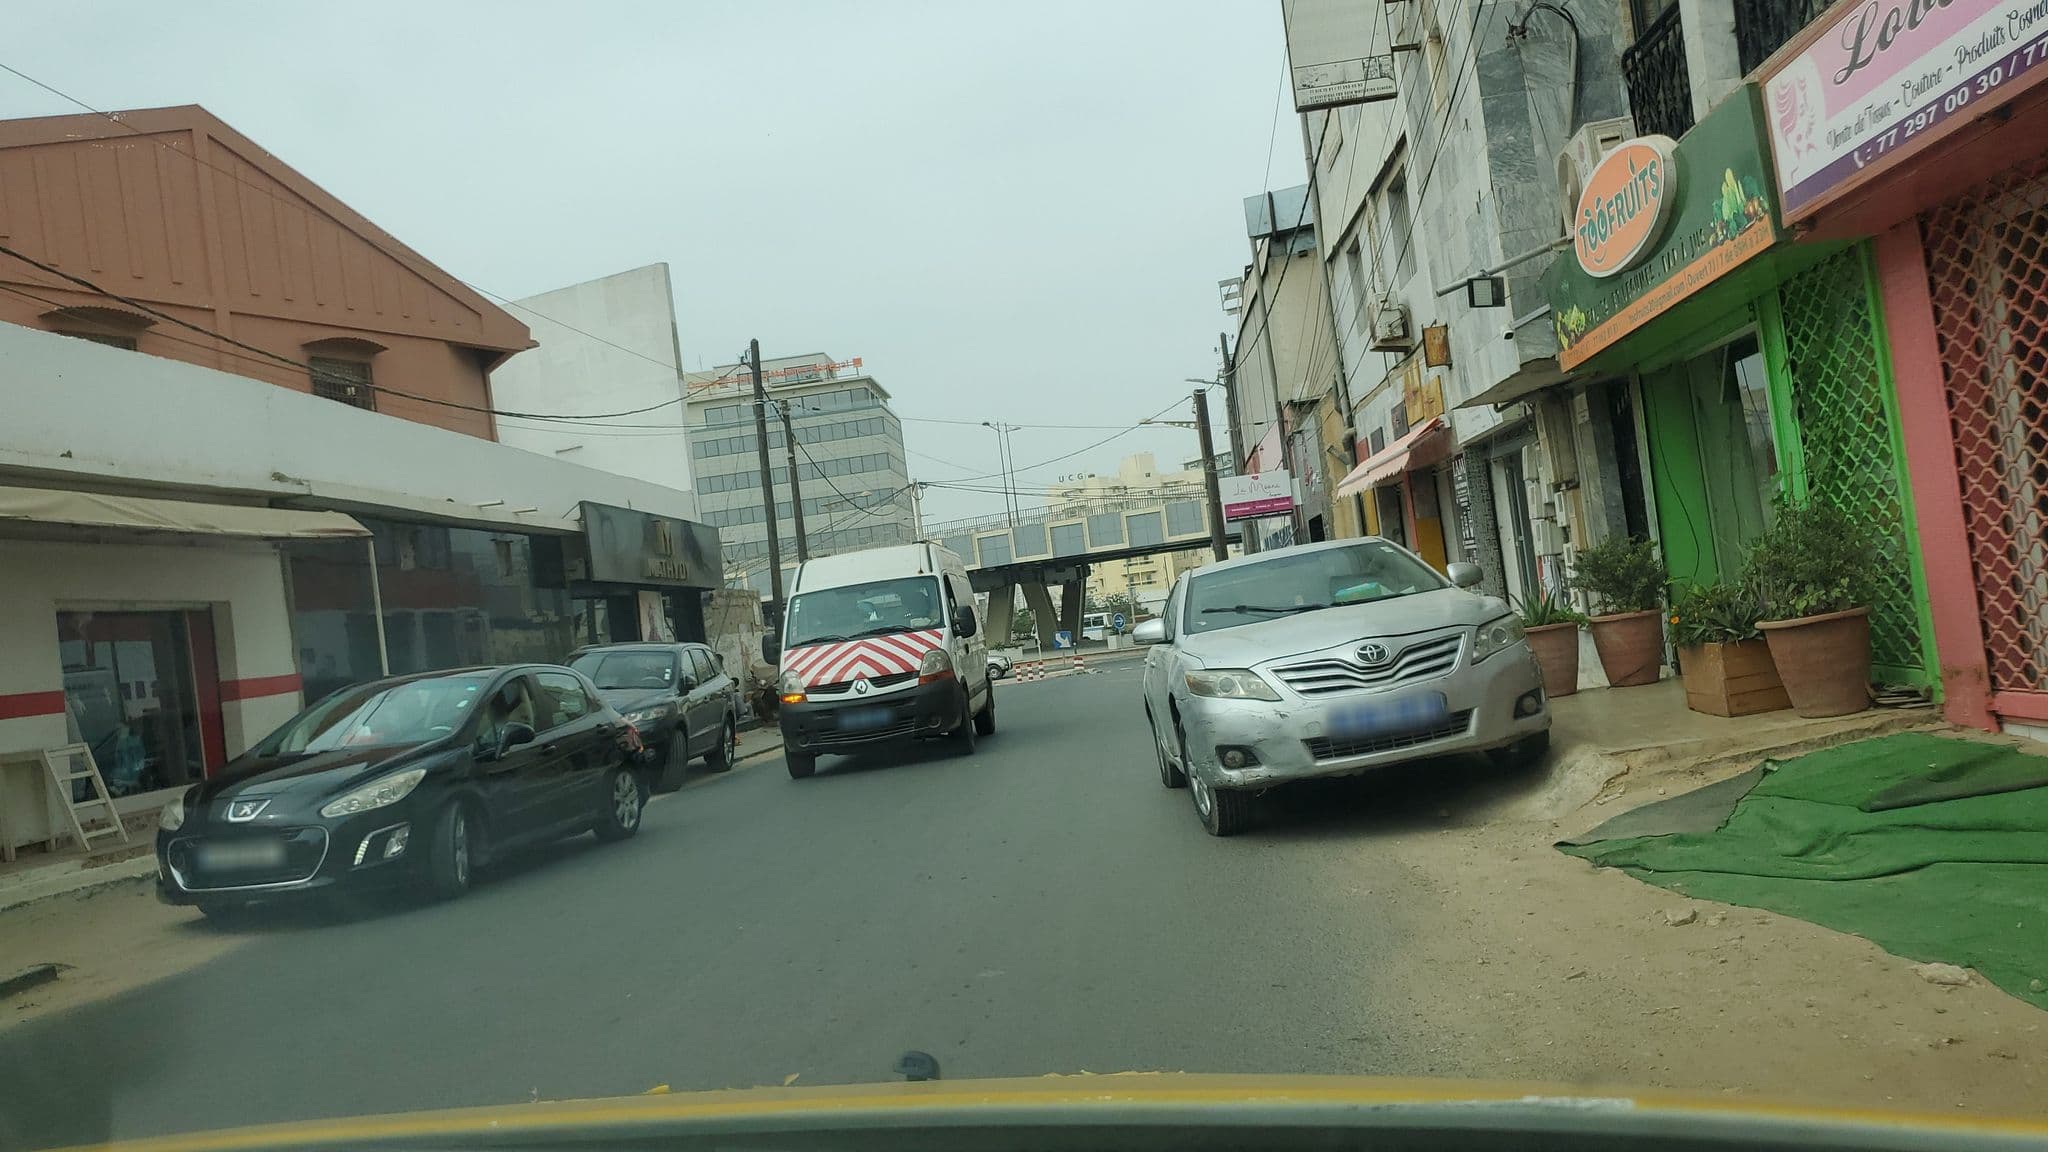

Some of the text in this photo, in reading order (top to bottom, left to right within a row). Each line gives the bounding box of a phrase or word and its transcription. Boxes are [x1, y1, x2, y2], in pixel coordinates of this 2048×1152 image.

[1901, 67, 1942, 108] Couture
[1954, 25, 2006, 75] Produits
[1876, 127, 1899, 154] 77
[1903, 103, 1938, 138] 297
[1944, 86, 1970, 113] 00
[1976, 66, 2003, 95] 30
